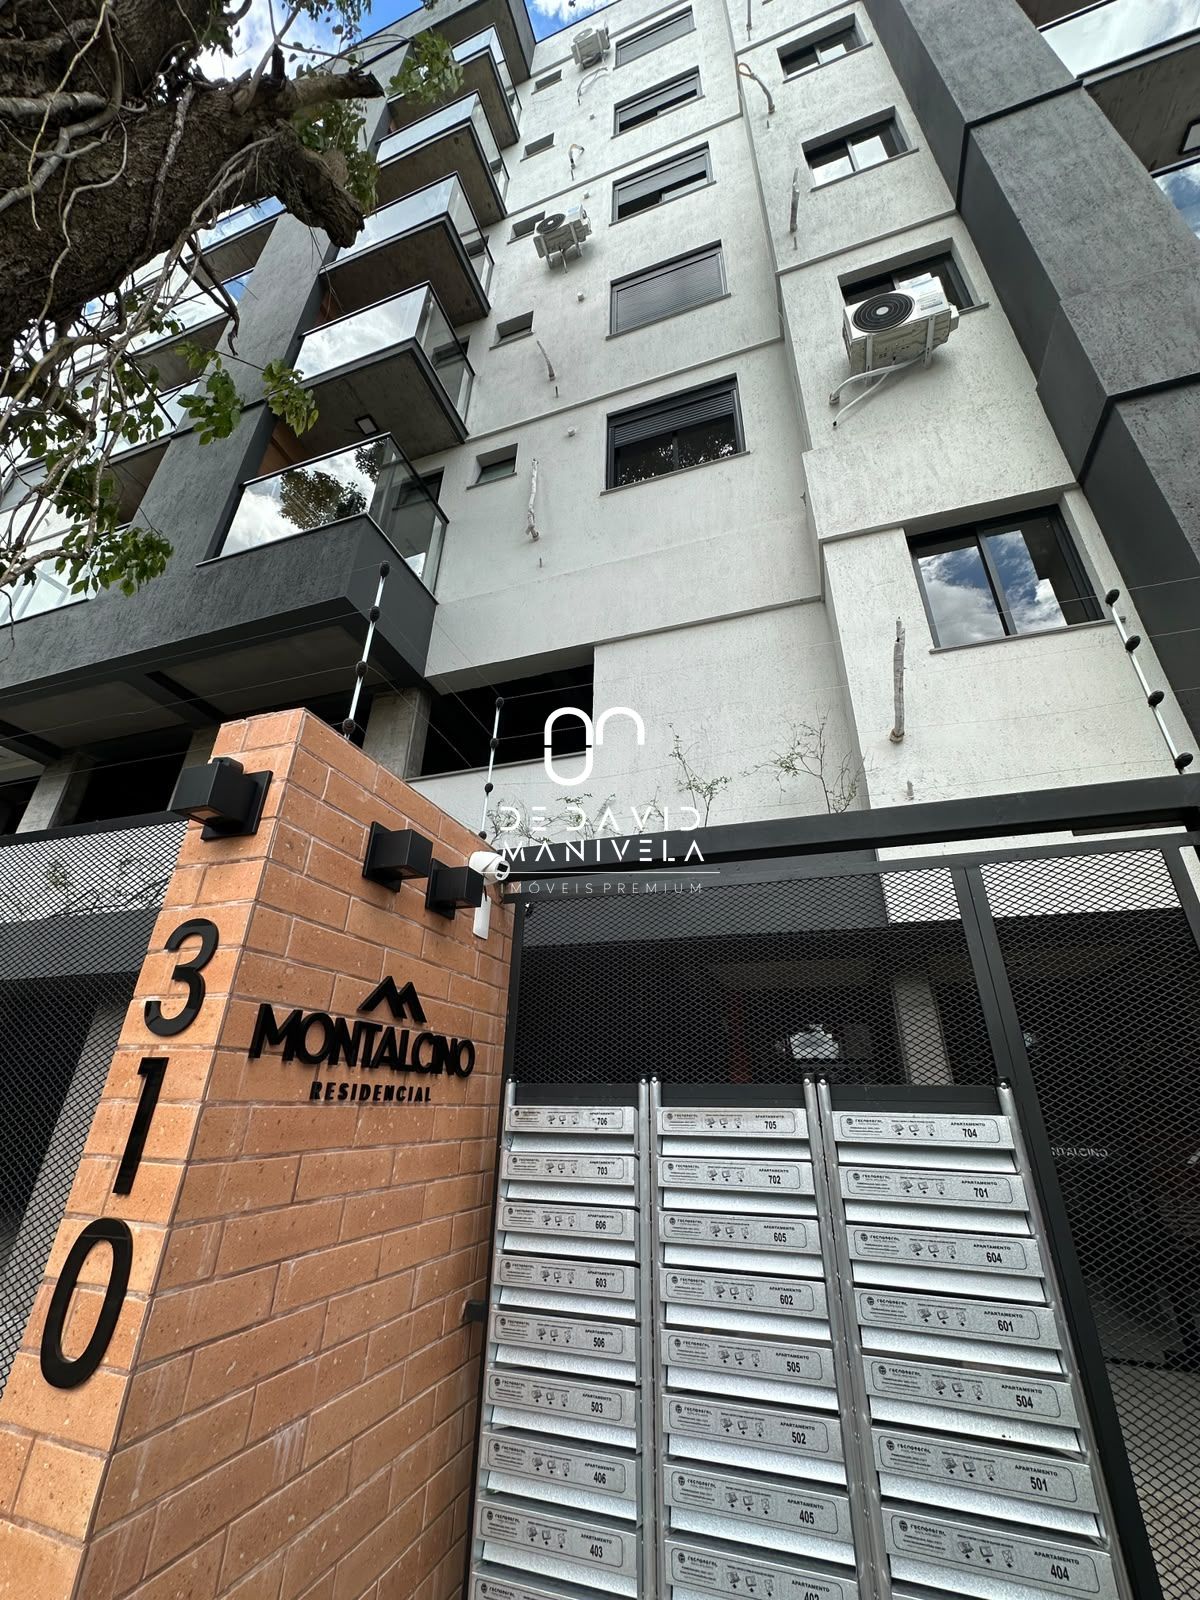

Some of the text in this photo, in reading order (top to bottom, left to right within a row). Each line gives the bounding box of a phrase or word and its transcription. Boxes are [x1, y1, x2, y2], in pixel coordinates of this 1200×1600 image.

[248, 1003, 475, 1077] MONTALCINO
[310, 1082, 431, 1101] RESIDENCIAL
[597, 1117, 608, 1126] 706
[764, 1121, 777, 1130] 705
[962, 1128, 977, 1138] 704
[597, 1167, 608, 1176] 703
[768, 1175, 781, 1185] 702
[974, 1188, 989, 1198] 701
[595, 1220, 607, 1230] 606
[773, 1232, 787, 1243] 605
[986, 1252, 1002, 1263] 604
[595, 1278, 607, 1288] 603
[780, 1294, 793, 1306] 602
[984, 1310, 1023, 1318] APARTAMENTO
[998, 1320, 1013, 1332] 601
[593, 1337, 605, 1348] 506
[775, 1352, 809, 1360] APARTAMENTO
[787, 1361, 801, 1373] 505
[1001, 1384, 1042, 1394] APARTAMENTO
[582, 1393, 612, 1402] APARTAMENTO
[1016, 1396, 1033, 1409] 504
[591, 1402, 603, 1413] 503
[780, 1422, 815, 1431] APARTAMENTO
[792, 1432, 807, 1444] 502
[585, 1462, 615, 1472] APARTAMENTO
[1015, 1464, 1058, 1477] APARTAMENTO
[593, 1472, 607, 1484] 406
[1030, 1477, 1047, 1492] 501
[787, 1498, 824, 1510] APARTAMENTO
[800, 1511, 815, 1524] 405
[581, 1534, 612, 1544] APARTAMENTO
[590, 1545, 603, 1558] 403
[1034, 1551, 1079, 1565] APARTAMENTO
[1050, 1565, 1069, 1580] 404
[792, 1580, 830, 1592] APARTAMENTO
